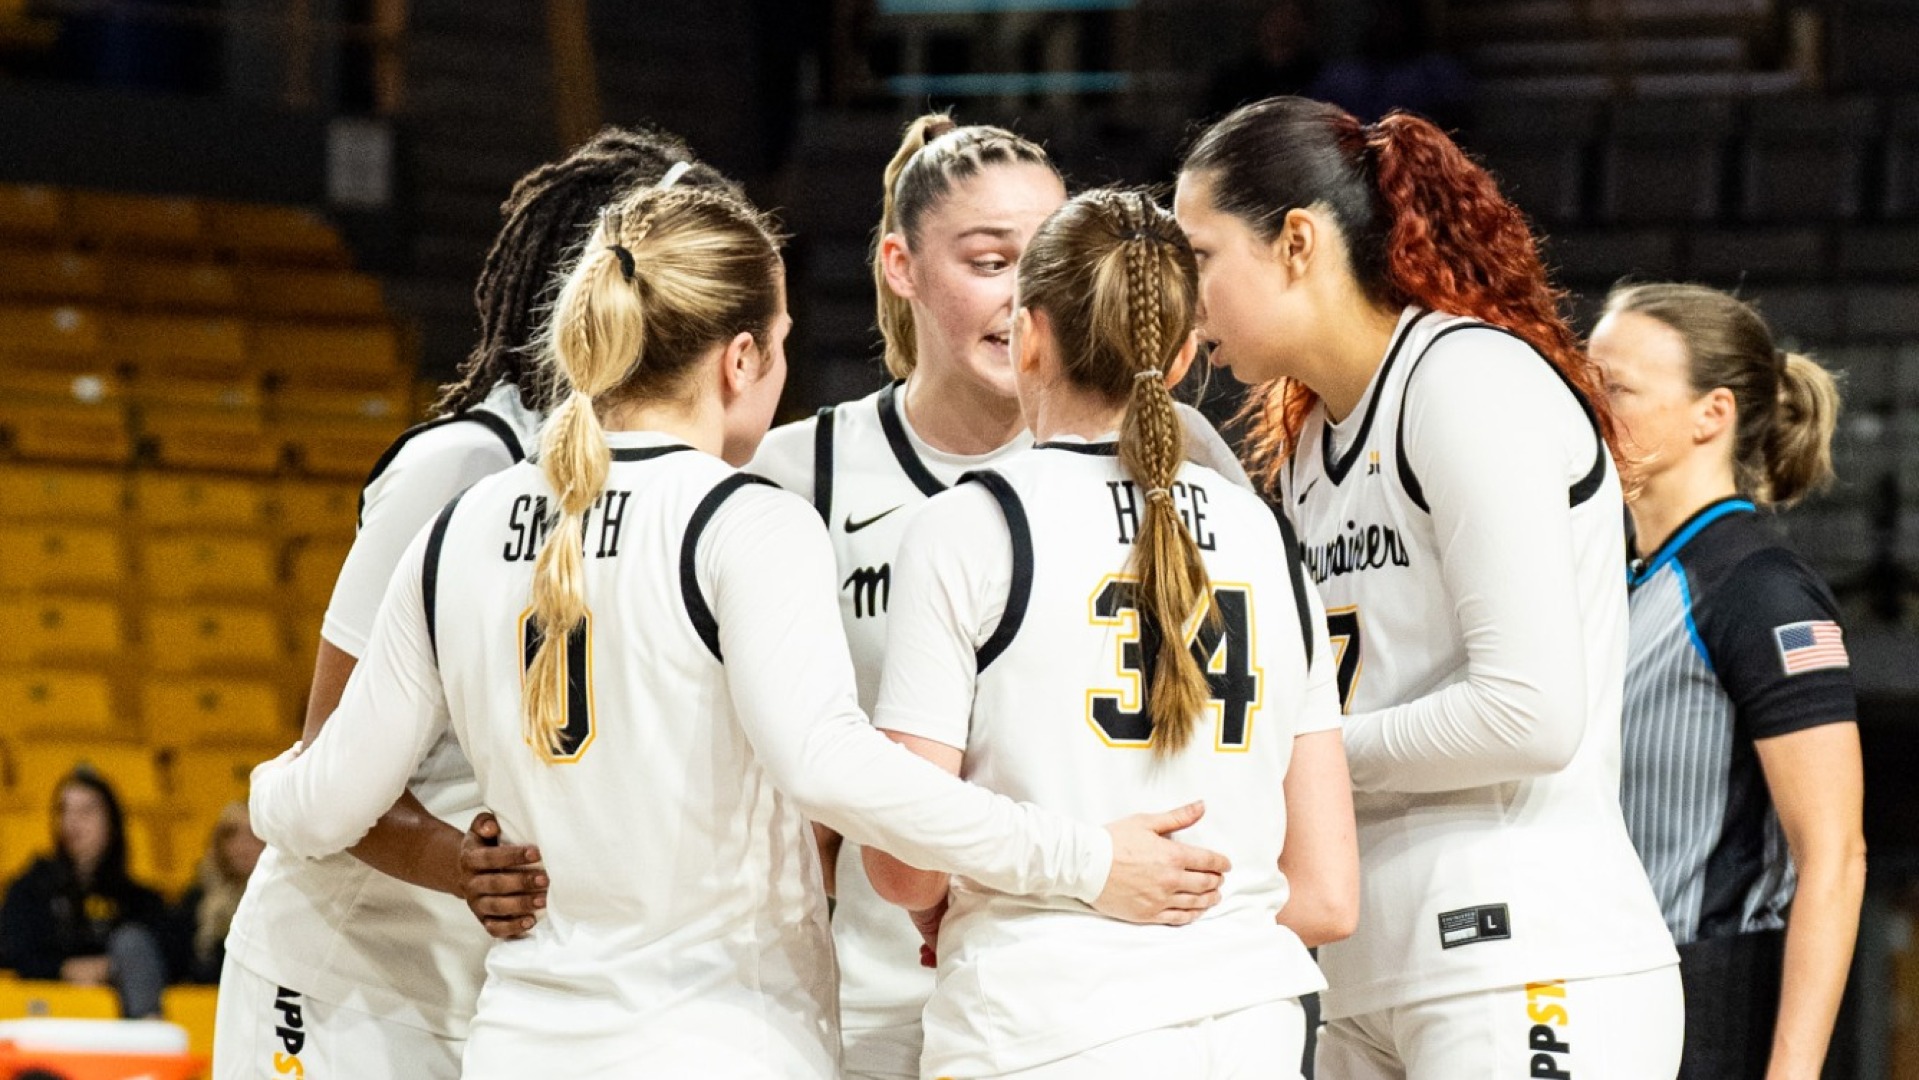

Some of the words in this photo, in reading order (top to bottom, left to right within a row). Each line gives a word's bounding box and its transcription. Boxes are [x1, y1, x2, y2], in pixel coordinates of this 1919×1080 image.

[503, 490, 631, 561] SMTH
[1106, 480, 1216, 551] HGE
[1086, 573, 1264, 753] 34
[1487, 915, 1497, 929] L
